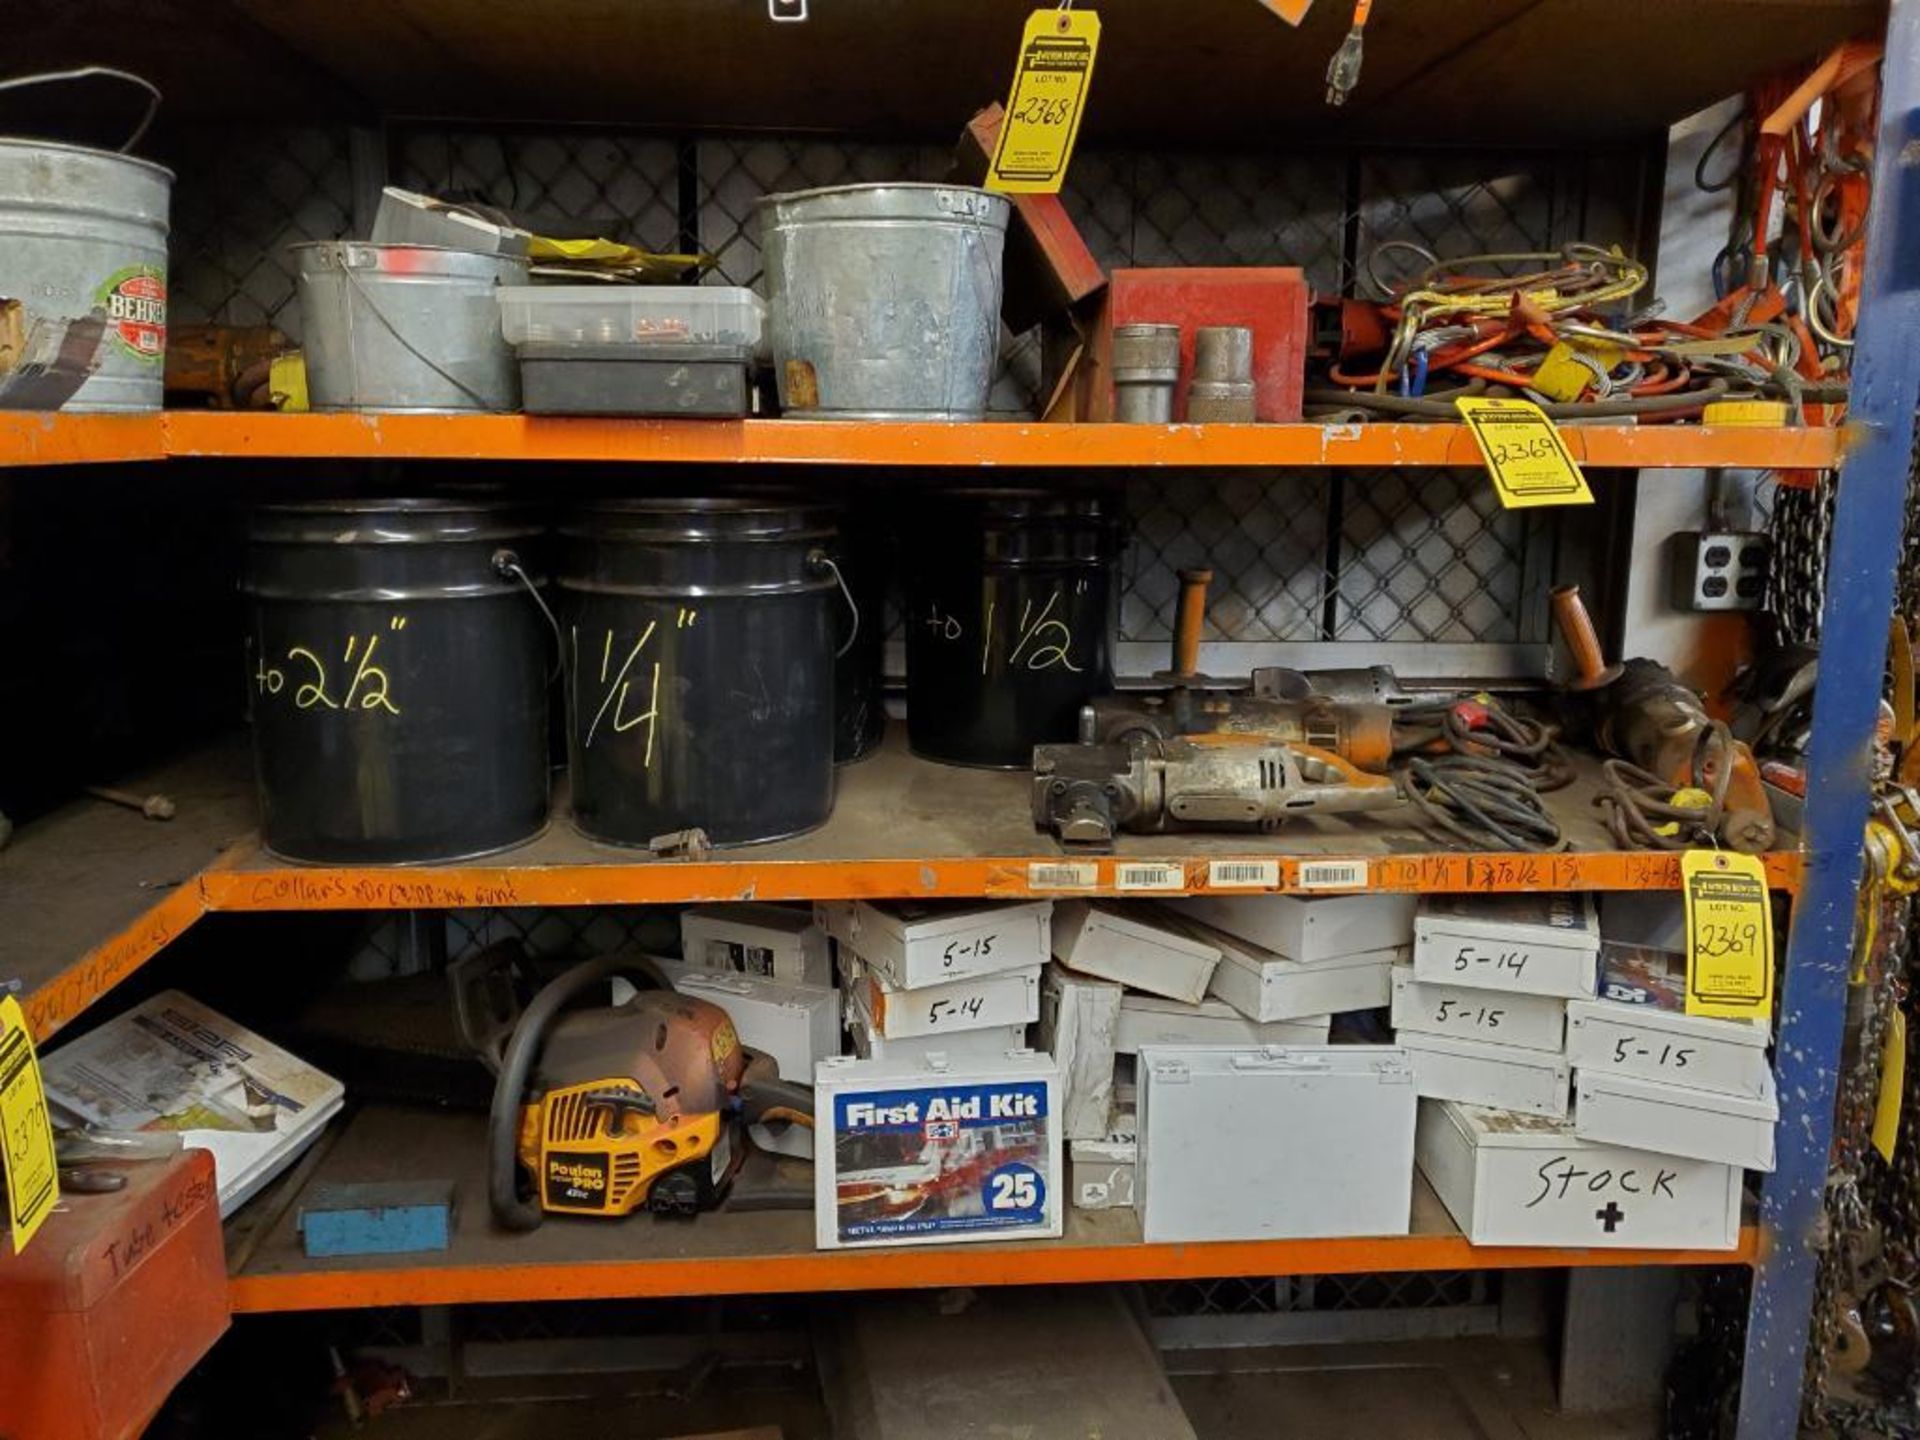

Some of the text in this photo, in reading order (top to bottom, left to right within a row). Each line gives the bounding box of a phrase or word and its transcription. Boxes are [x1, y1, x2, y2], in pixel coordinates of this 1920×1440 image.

[1014, 97, 1072, 125] 2368
[1493, 438, 1558, 465] 2369
[932, 603, 962, 639] to
[255, 658, 284, 696] to
[1709, 903, 1726, 911] LOT
[943, 935, 999, 968] 5-15
[1696, 922, 1757, 957] 2369
[1454, 947, 1530, 978] 5-14
[929, 997, 984, 1024] 5-14
[1435, 1001, 1506, 1028] 5-15
[1613, 1037, 1696, 1068] 5-15
[845, 1093, 1038, 1127] First Aid Kit
[550, 1161, 602, 1179] Poulan
[991, 1172, 1038, 1210] 25
